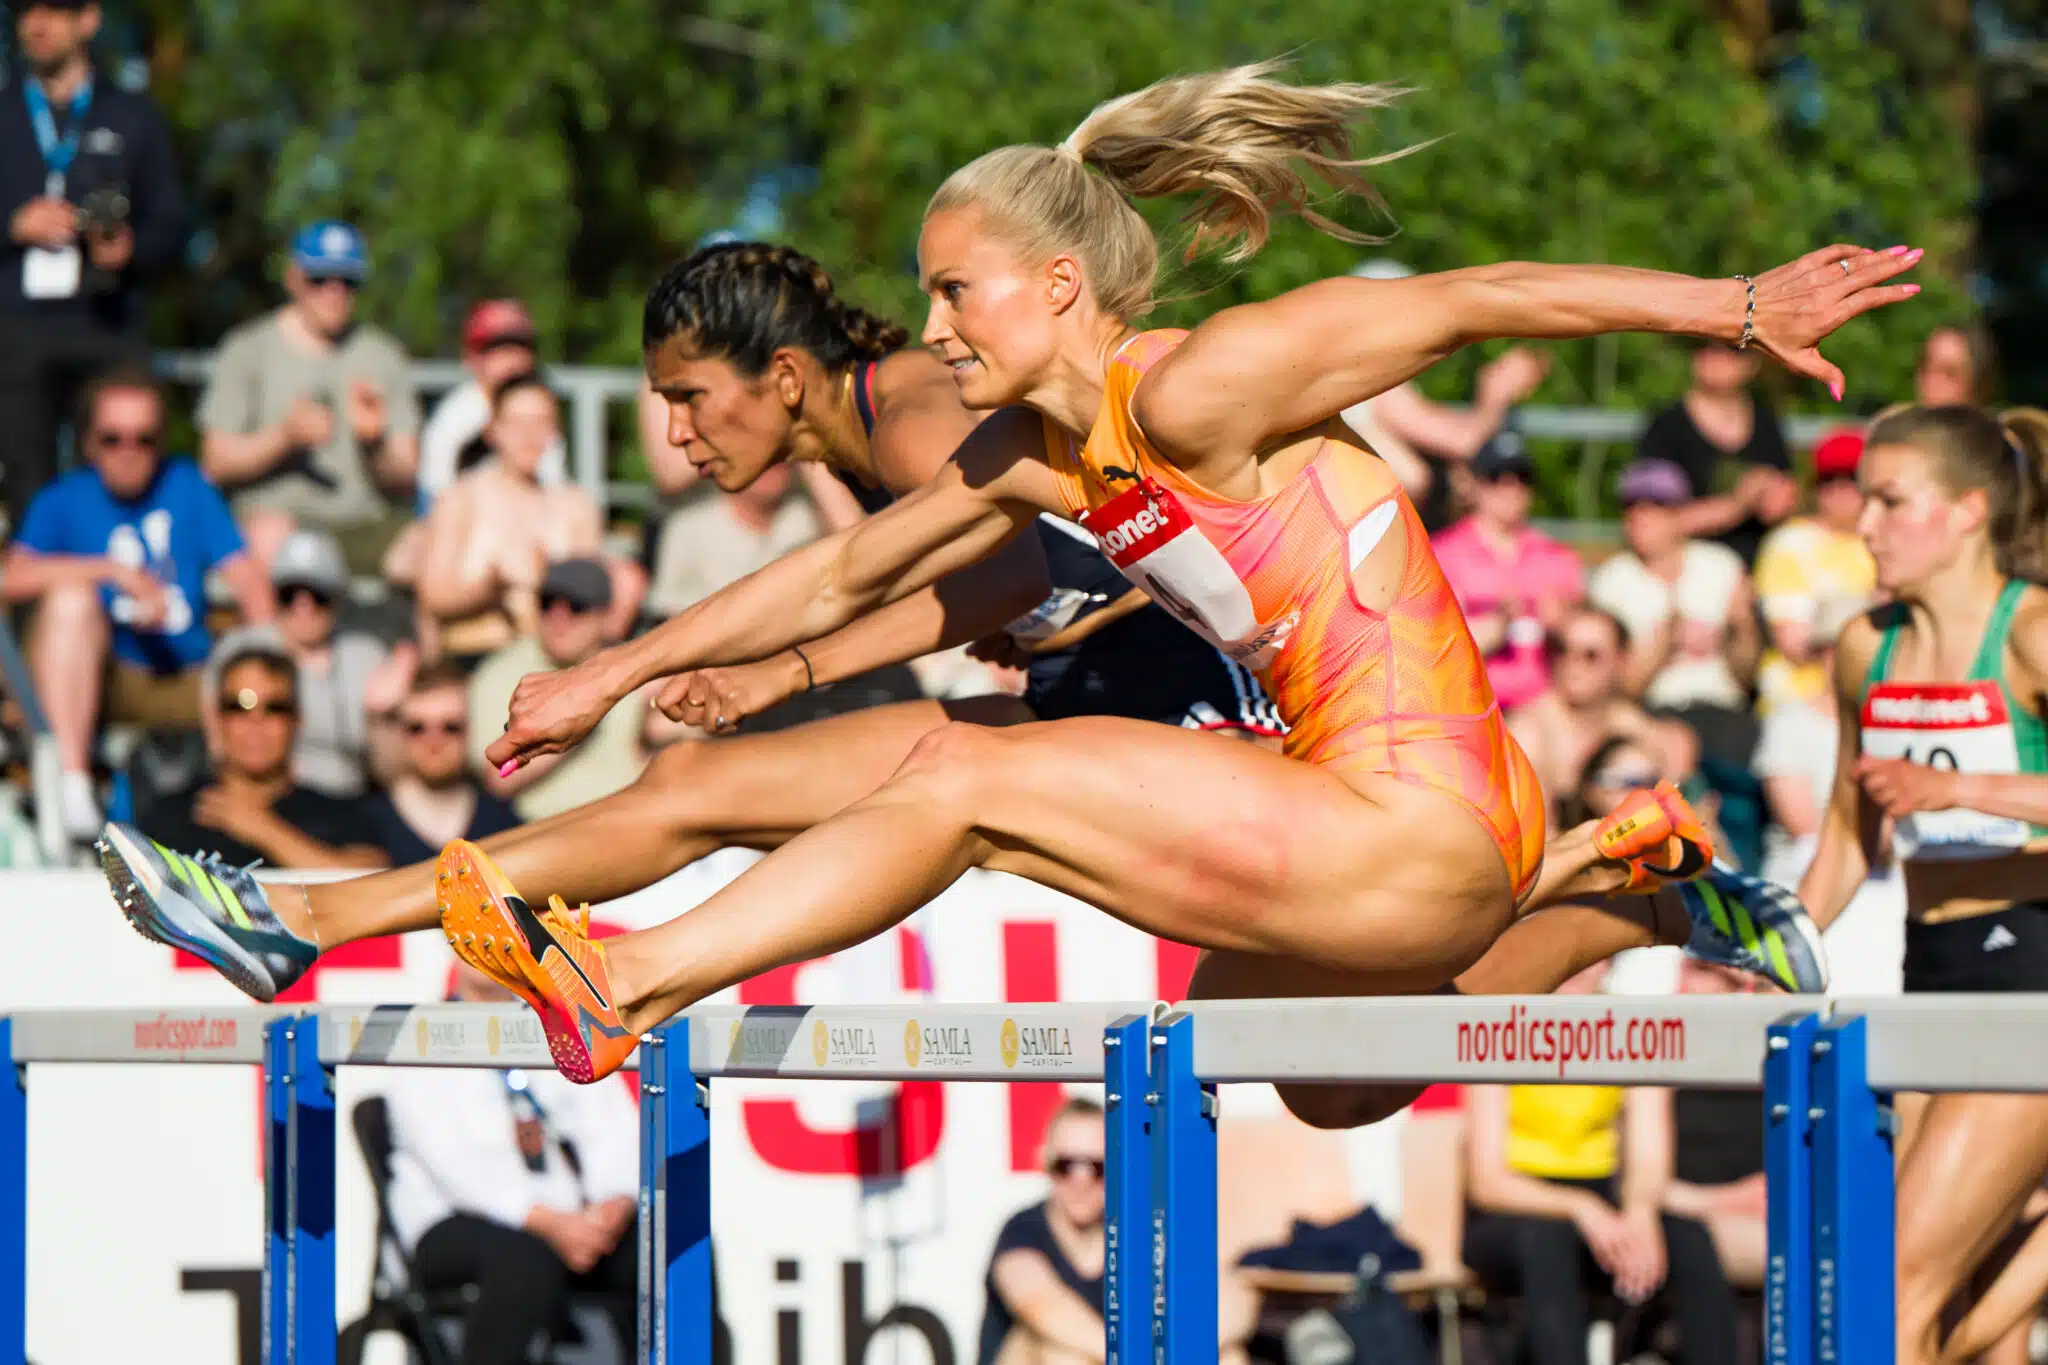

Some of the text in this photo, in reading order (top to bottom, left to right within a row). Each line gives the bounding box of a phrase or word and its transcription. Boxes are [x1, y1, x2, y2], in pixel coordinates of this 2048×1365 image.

[1098, 499, 1169, 556] tonet
[831, 1028, 877, 1055] SAMLA
[924, 1028, 972, 1055] SAMLA
[1021, 1028, 1073, 1056] SAMLA
[1457, 1004, 1685, 1078] nordicsport.com
